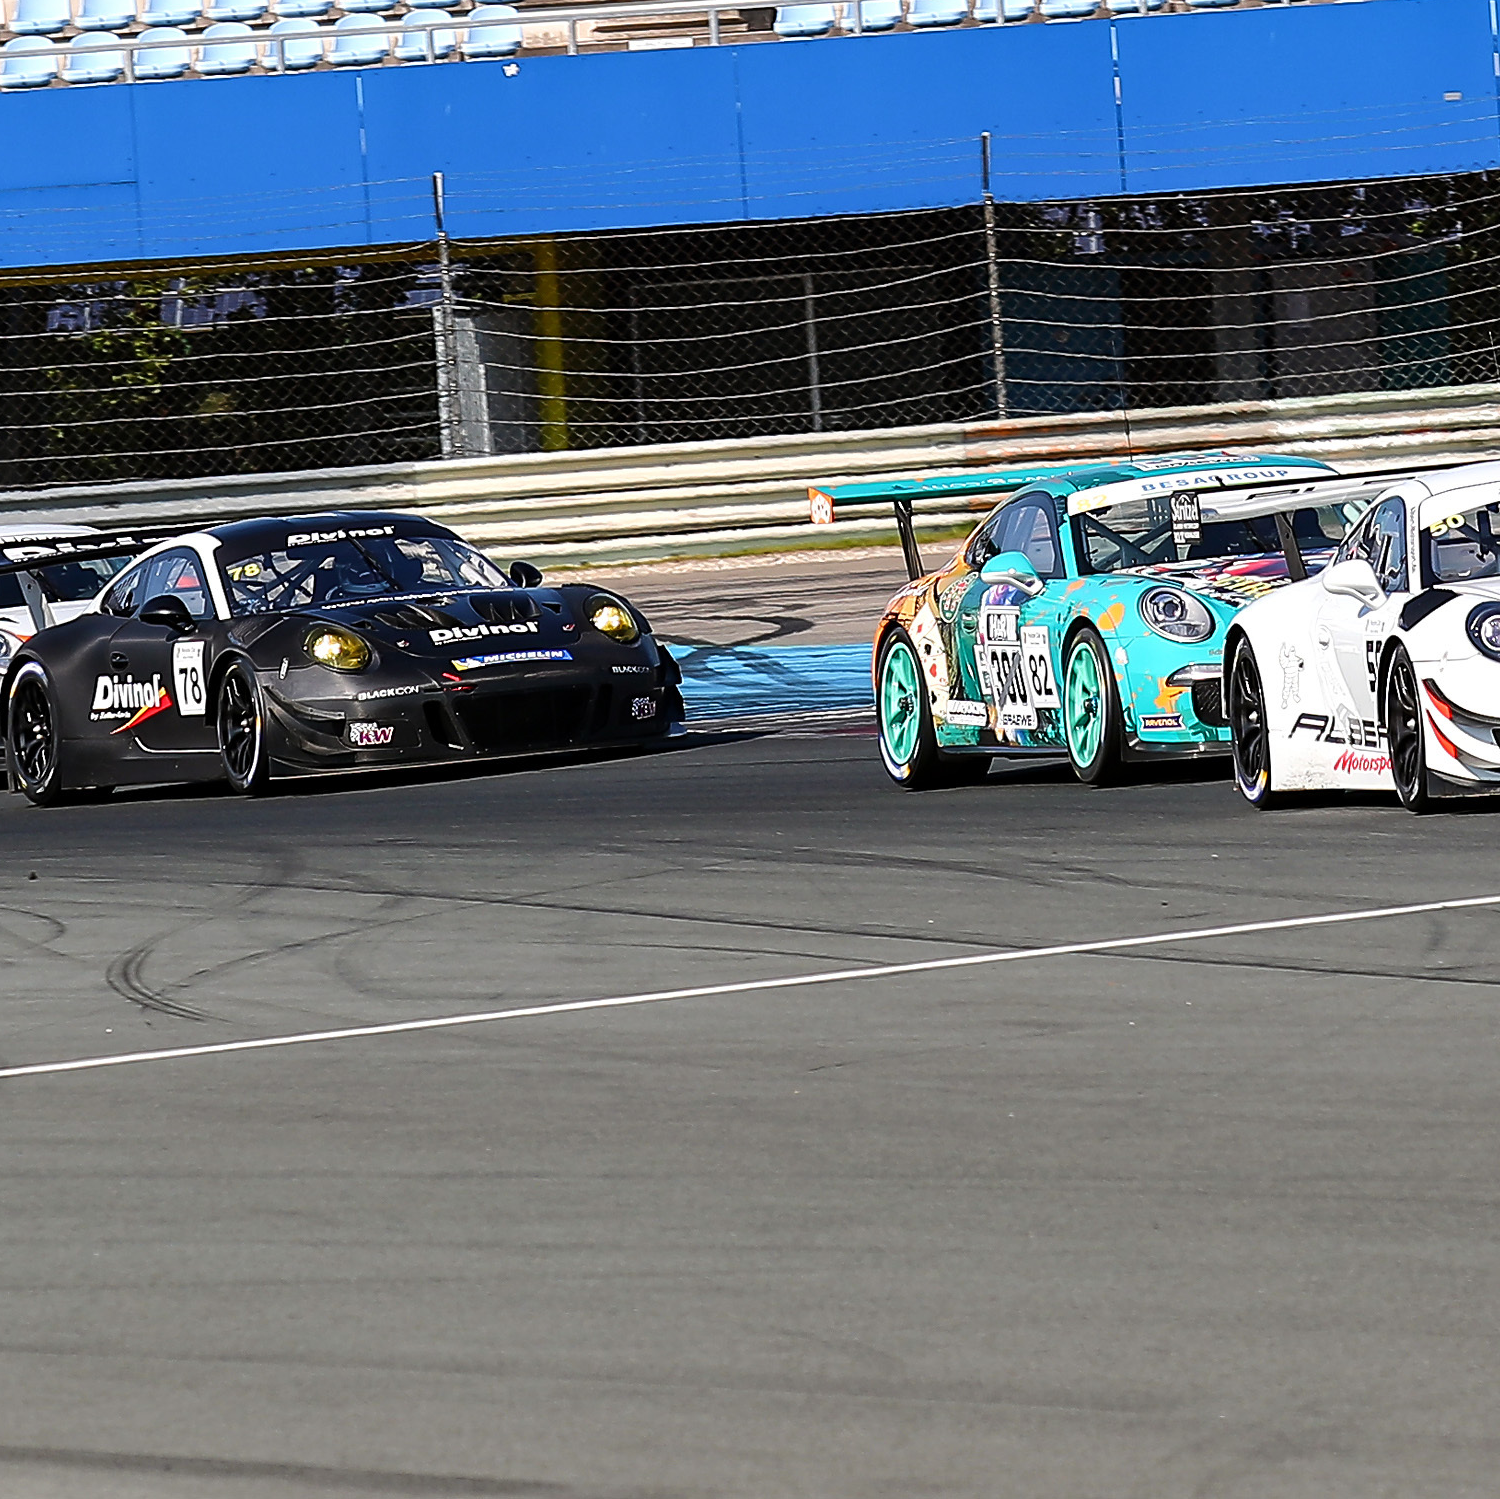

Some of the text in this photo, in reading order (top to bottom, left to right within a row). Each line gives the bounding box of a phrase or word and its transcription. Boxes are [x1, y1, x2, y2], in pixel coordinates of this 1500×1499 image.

[286, 525, 395, 544] Divinol
[1429, 513, 1466, 538] 50
[227, 562, 261, 581] 78
[428, 621, 539, 643] Divinol
[483, 650, 564, 664] MICHELIN
[178, 666, 203, 705] 78
[1029, 654, 1054, 697] 82
[92, 673, 161, 710] Divinol
